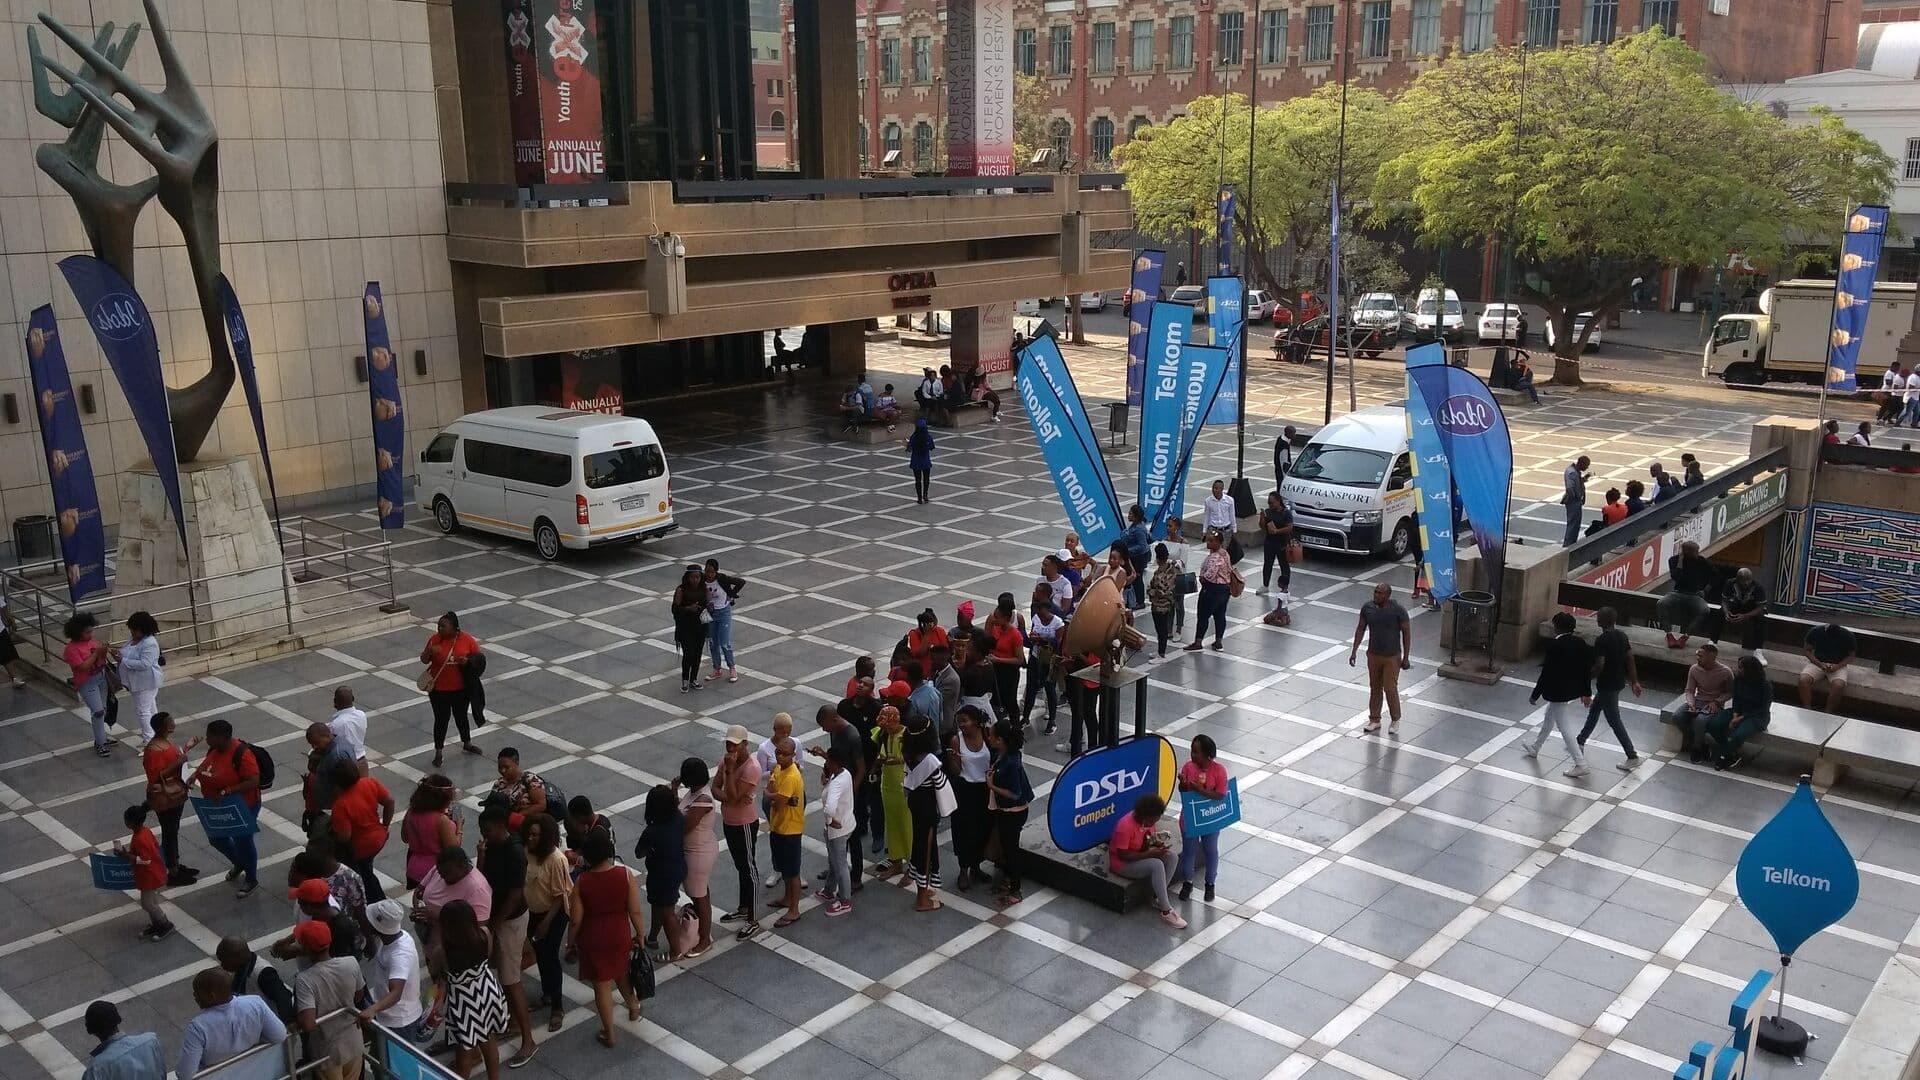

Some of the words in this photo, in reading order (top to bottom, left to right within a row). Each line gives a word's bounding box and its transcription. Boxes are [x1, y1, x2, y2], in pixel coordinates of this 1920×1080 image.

[515, 63, 523, 97] Youth
[557, 81, 571, 123] Youth
[994, 65, 1004, 146] WOMEN'S
[517, 148, 542, 162] JUNE
[548, 140, 602, 151] ANNUALLY
[550, 152, 604, 174] JUNE
[977, 155, 1010, 164] ANNUALLY
[978, 165, 1010, 176] AUGUST
[888, 271, 937, 291] OPERA
[1155, 322, 1182, 401] Telkom
[570, 395, 621, 410] ANNUALLY
[1144, 433, 1171, 508] Telkom
[1282, 483, 1308, 494] STAFF
[1309, 485, 1371, 504] TRANSPORT
[1739, 482, 1769, 512] PARKING
[1075, 765, 1150, 809] DStv
[1074, 802, 1116, 828] Compact
[1200, 801, 1227, 818] Telkom
[1762, 866, 1831, 892] Telkom
